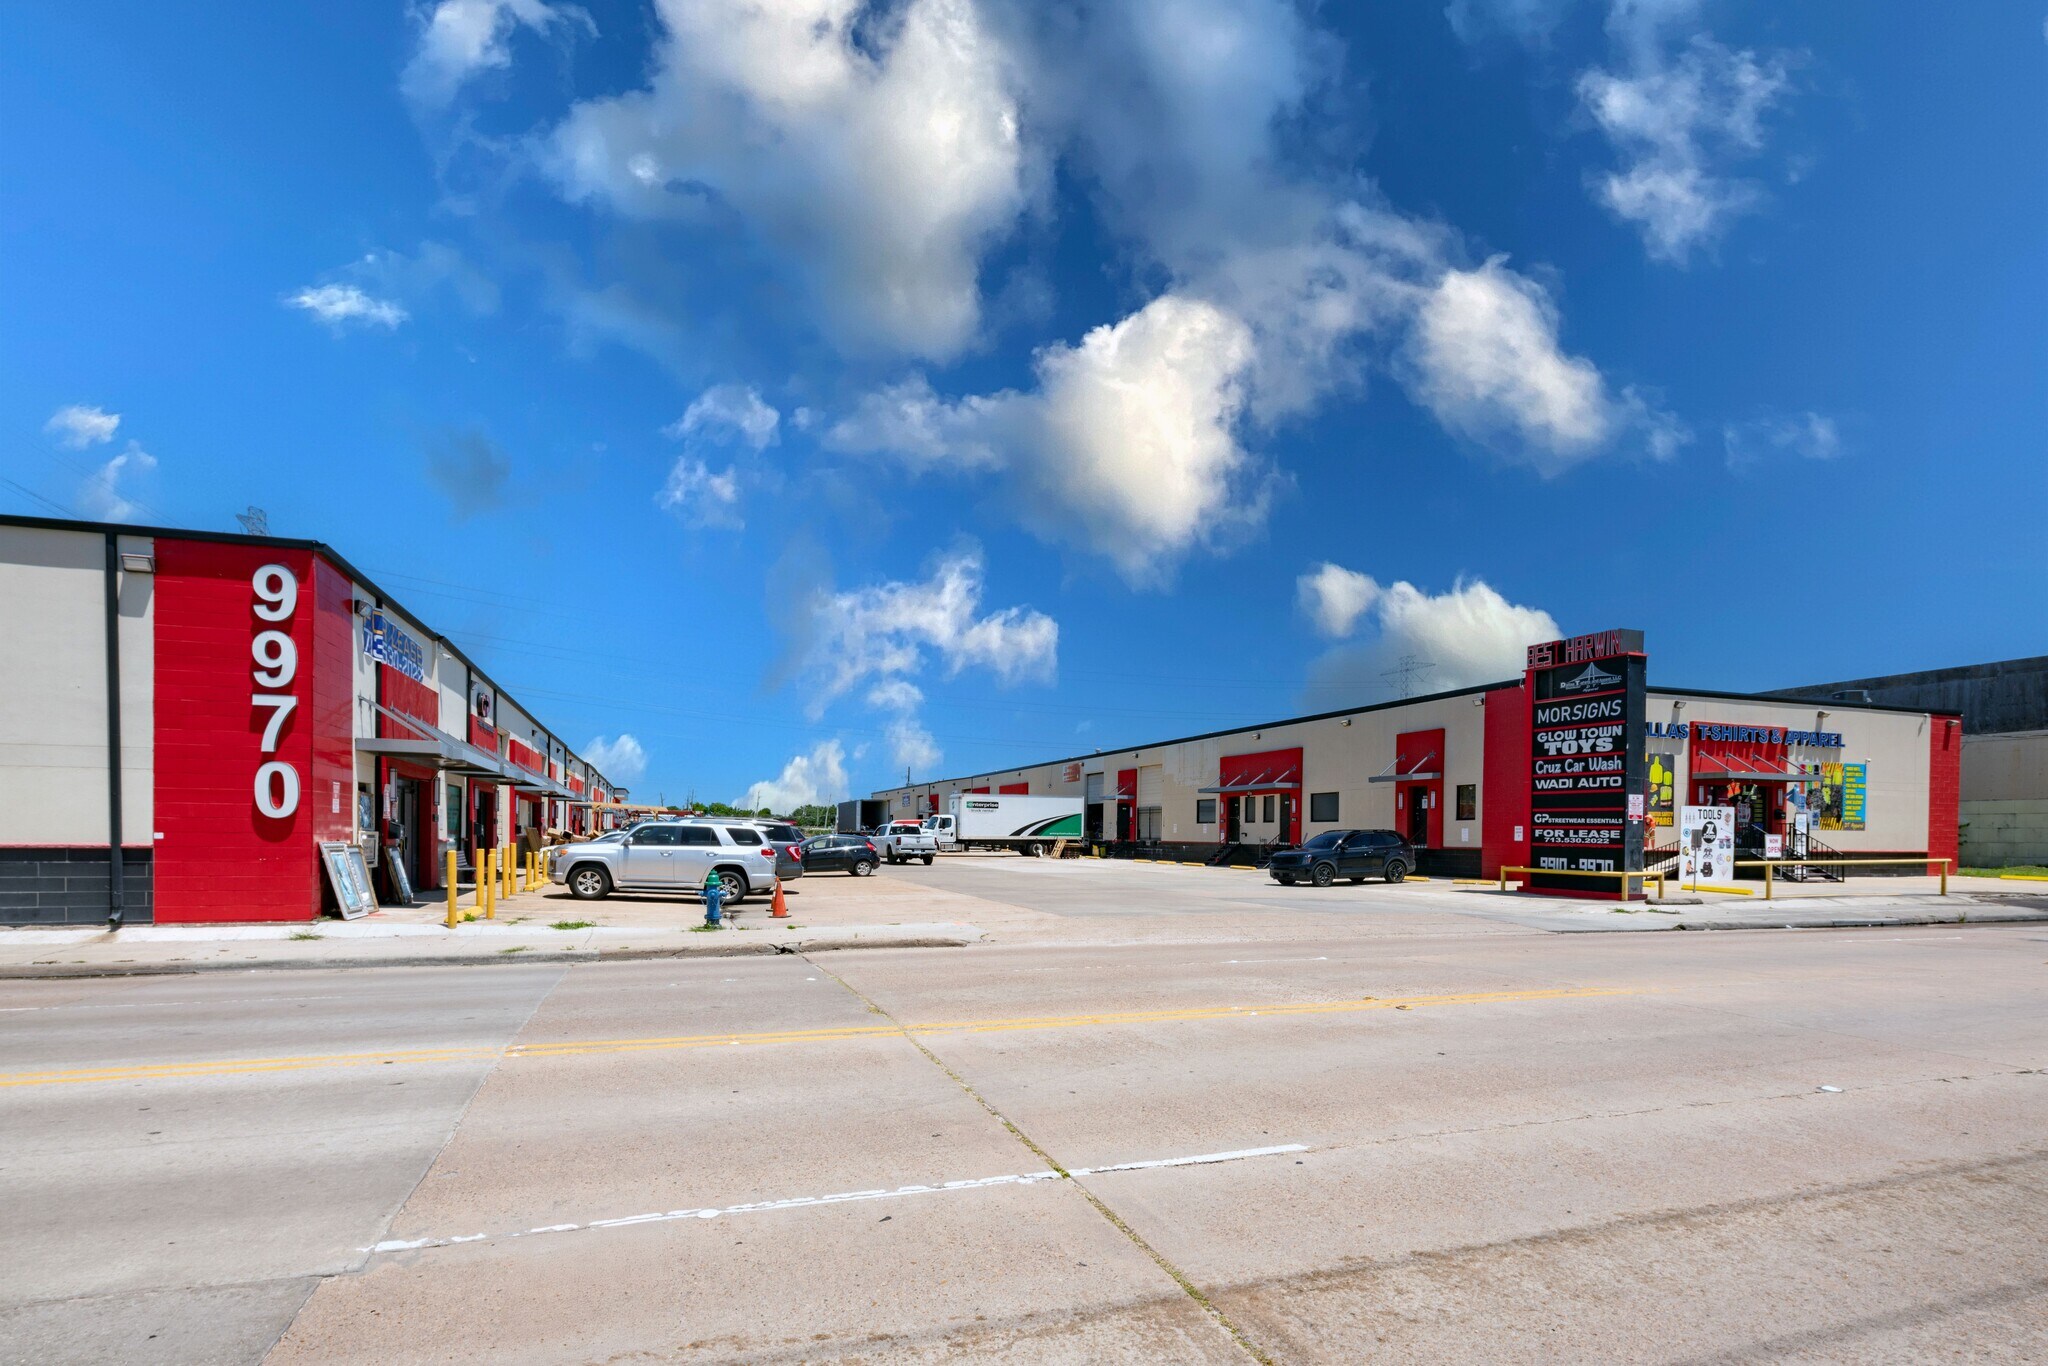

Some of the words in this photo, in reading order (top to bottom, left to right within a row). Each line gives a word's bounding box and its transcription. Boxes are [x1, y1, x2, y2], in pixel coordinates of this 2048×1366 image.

[391, 624, 424, 668] LEASE
[1527, 640, 1560, 669] BEST
[1565, 629, 1621, 663] HARWIN
[251, 563, 301, 819] 9970
[1537, 699, 1622, 724] MORSIGNS
[1537, 729, 1577, 743] GLOW
[1580, 725, 1623, 739] TOWN
[1646, 721, 1689, 739] LLAS
[1698, 724, 1768, 743] T-SHIRTS
[1770, 729, 1783, 744] &
[1785, 730, 1846, 748] APPAREL
[1543, 737, 1614, 756] TOYS
[1535, 760, 1562, 774] Cruz
[1564, 758, 1585, 773] Car
[1588, 755, 1622, 772] Wash
[1535, 778, 1573, 789] WADI
[1577, 776, 1622, 788] AUTO
[1697, 808, 1722, 820] TOOLS
[1534, 829, 1565, 838] FOR
[1569, 829, 1621, 839] LEASE
[1767, 846, 1782, 854] OPEN
[1540, 856, 1568, 870] 9910
[1579, 858, 1614, 872] 9970
